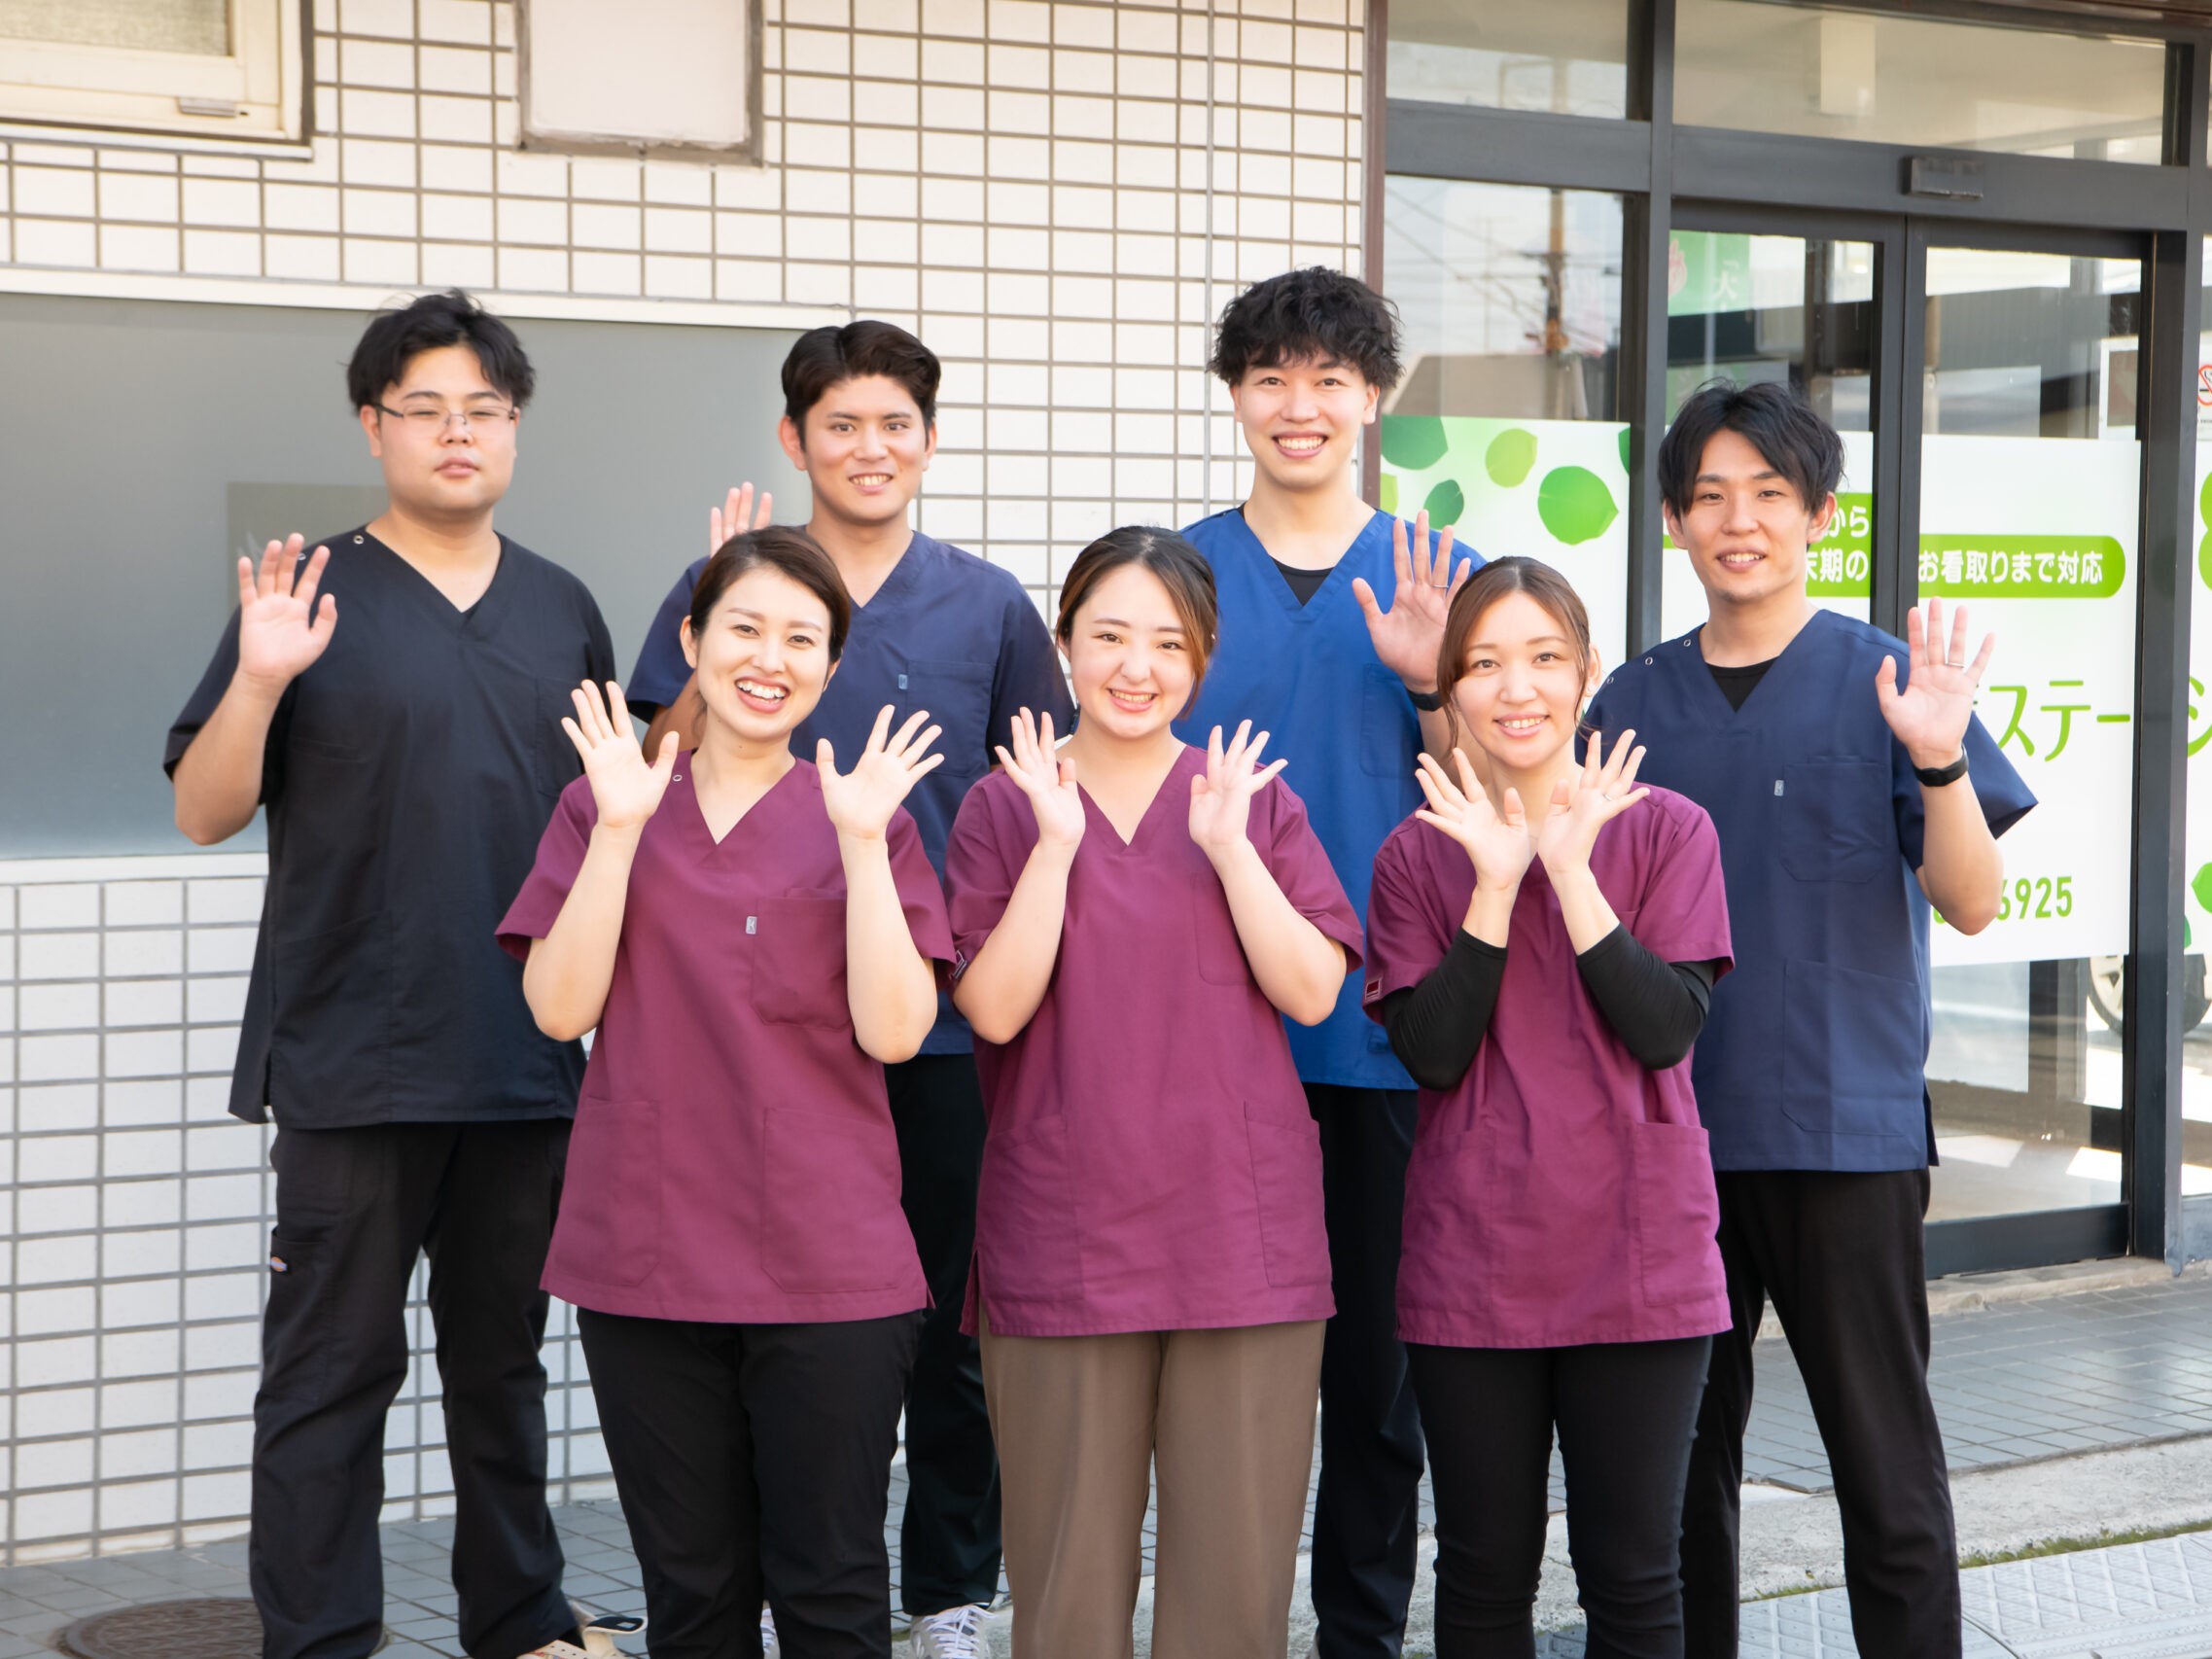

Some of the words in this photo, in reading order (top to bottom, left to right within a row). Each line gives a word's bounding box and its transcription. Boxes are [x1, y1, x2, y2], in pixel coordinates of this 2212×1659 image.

[1917, 549, 2103, 584] お看取りまで対応
